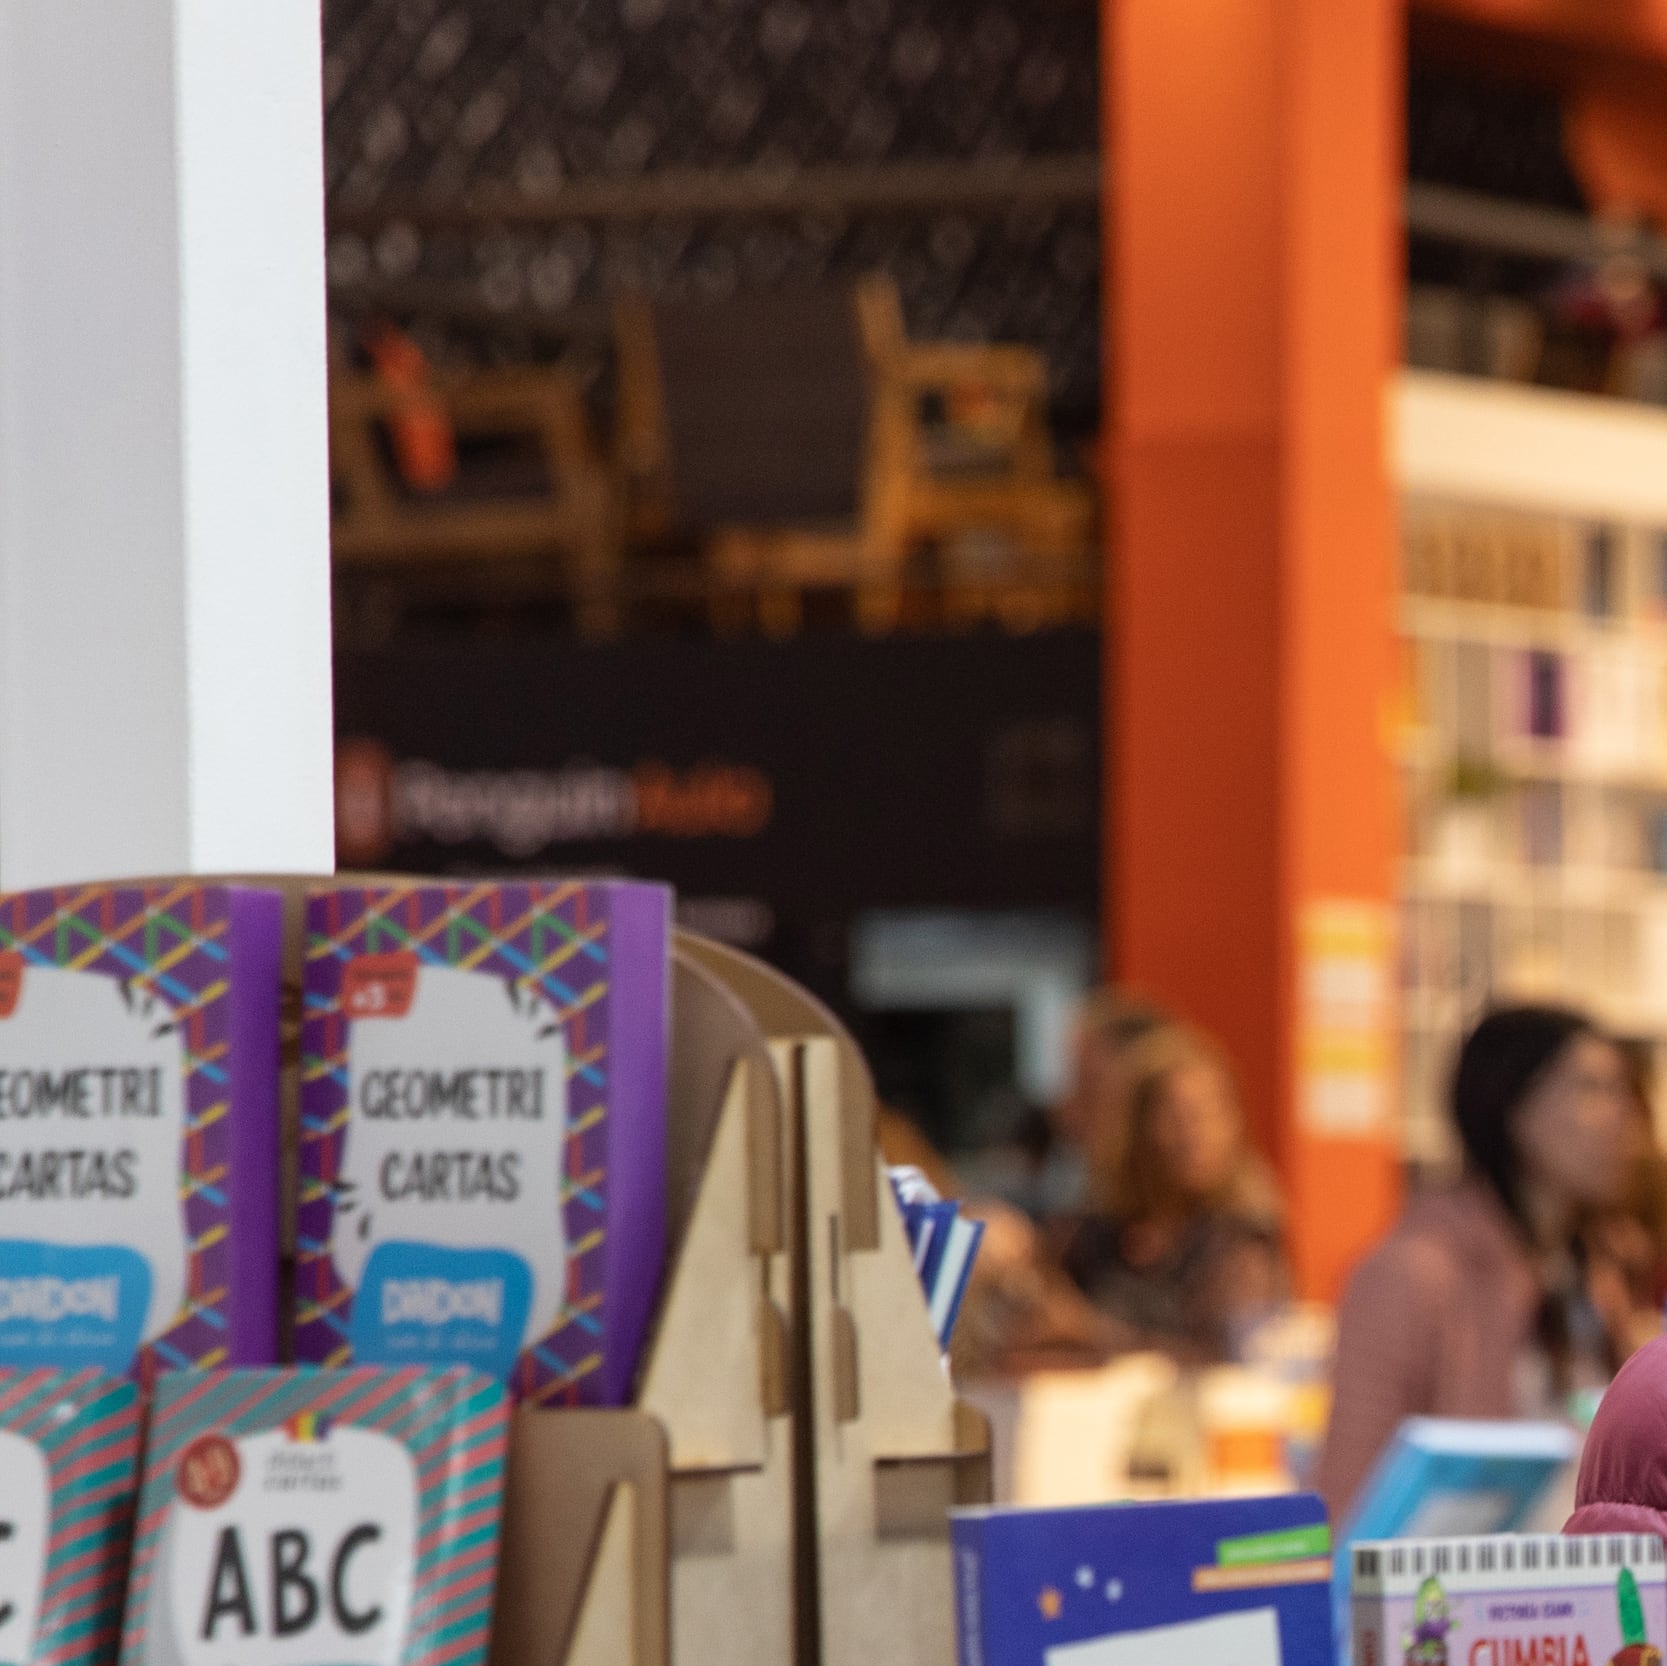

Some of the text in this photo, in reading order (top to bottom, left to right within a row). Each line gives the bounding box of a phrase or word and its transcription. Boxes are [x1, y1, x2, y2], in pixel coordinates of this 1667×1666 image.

[0, 1067, 161, 1119] EOMETRI
[358, 1068, 545, 1120] GEOMETRI
[380, 1151, 521, 1202] CARTAS
[199, 1522, 385, 1640] ABC
